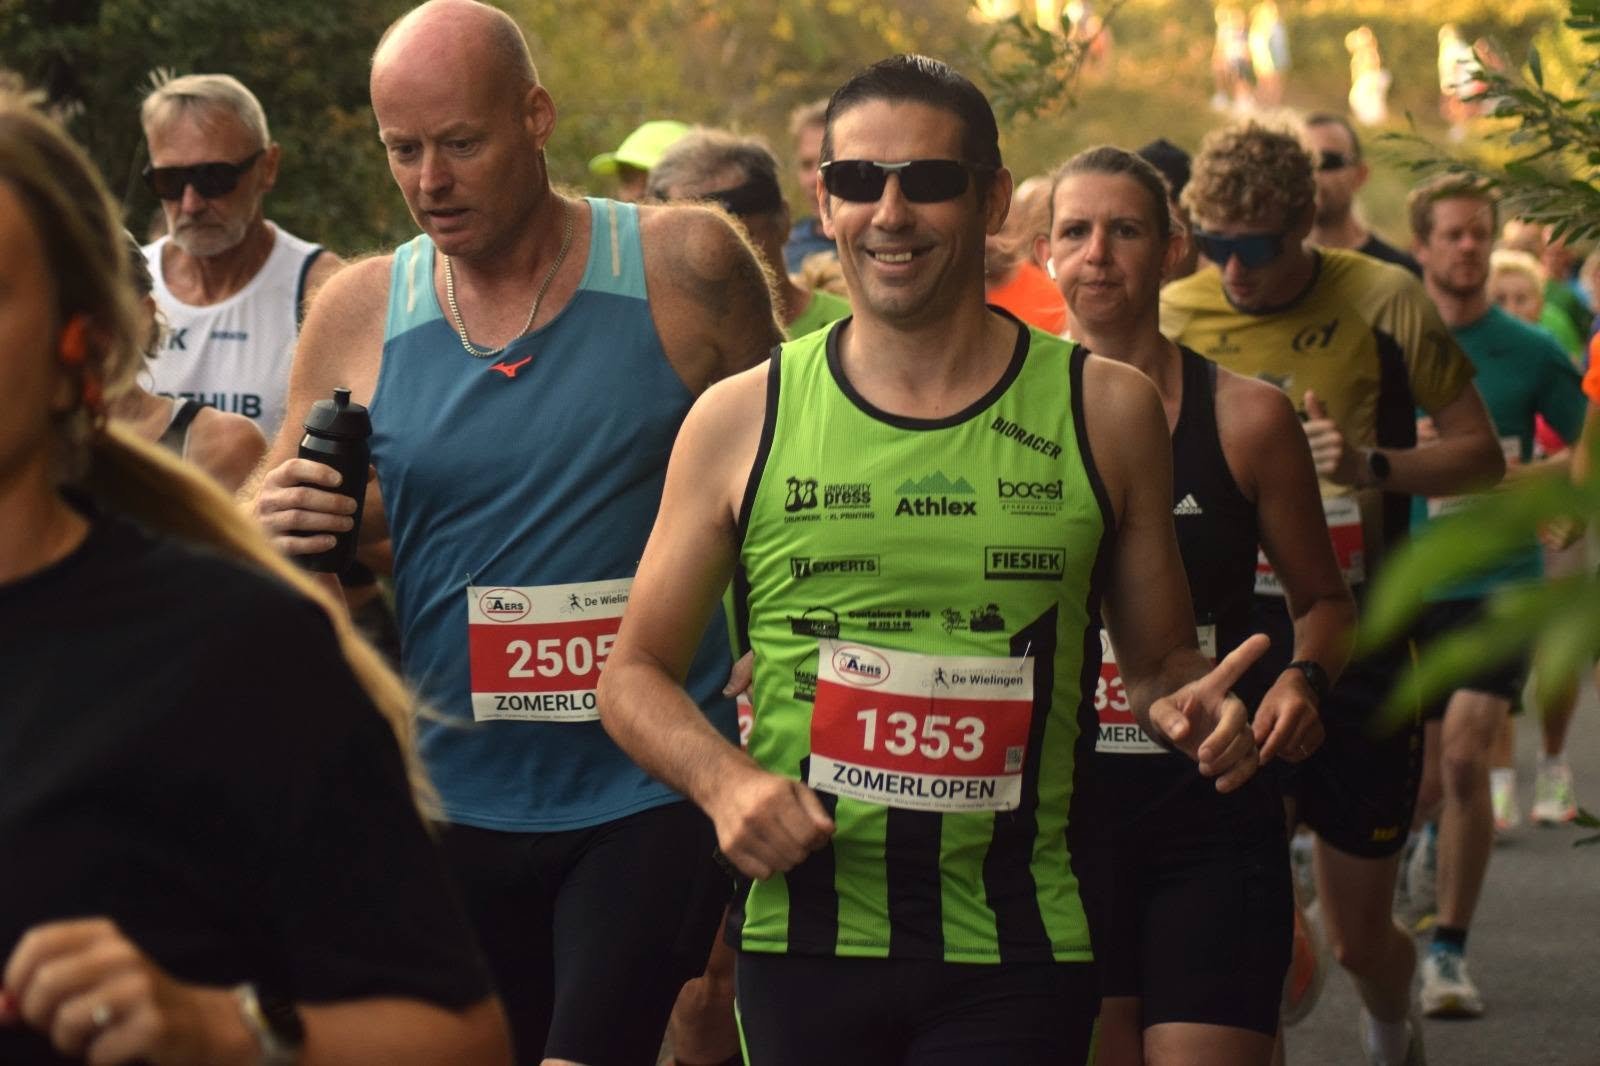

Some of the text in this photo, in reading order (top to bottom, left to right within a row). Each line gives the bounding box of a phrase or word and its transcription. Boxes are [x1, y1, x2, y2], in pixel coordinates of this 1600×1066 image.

[157, 391, 262, 418] HUB
[991, 416, 1062, 460] BIORACER
[824, 490, 871, 508] press
[895, 497, 977, 516] Athlex
[813, 560, 876, 573] EXPERTS
[992, 552, 1060, 570] FIESIEK
[585, 594, 629, 607] De Wielin
[951, 674, 1024, 688] De Wielingen
[494, 692, 597, 711] ZOMERLO
[1094, 676, 1131, 712] 33
[856, 708, 985, 761] 1353
[1098, 726, 1149, 742] MERL
[832, 763, 996, 799] ZOMERLOPEN
